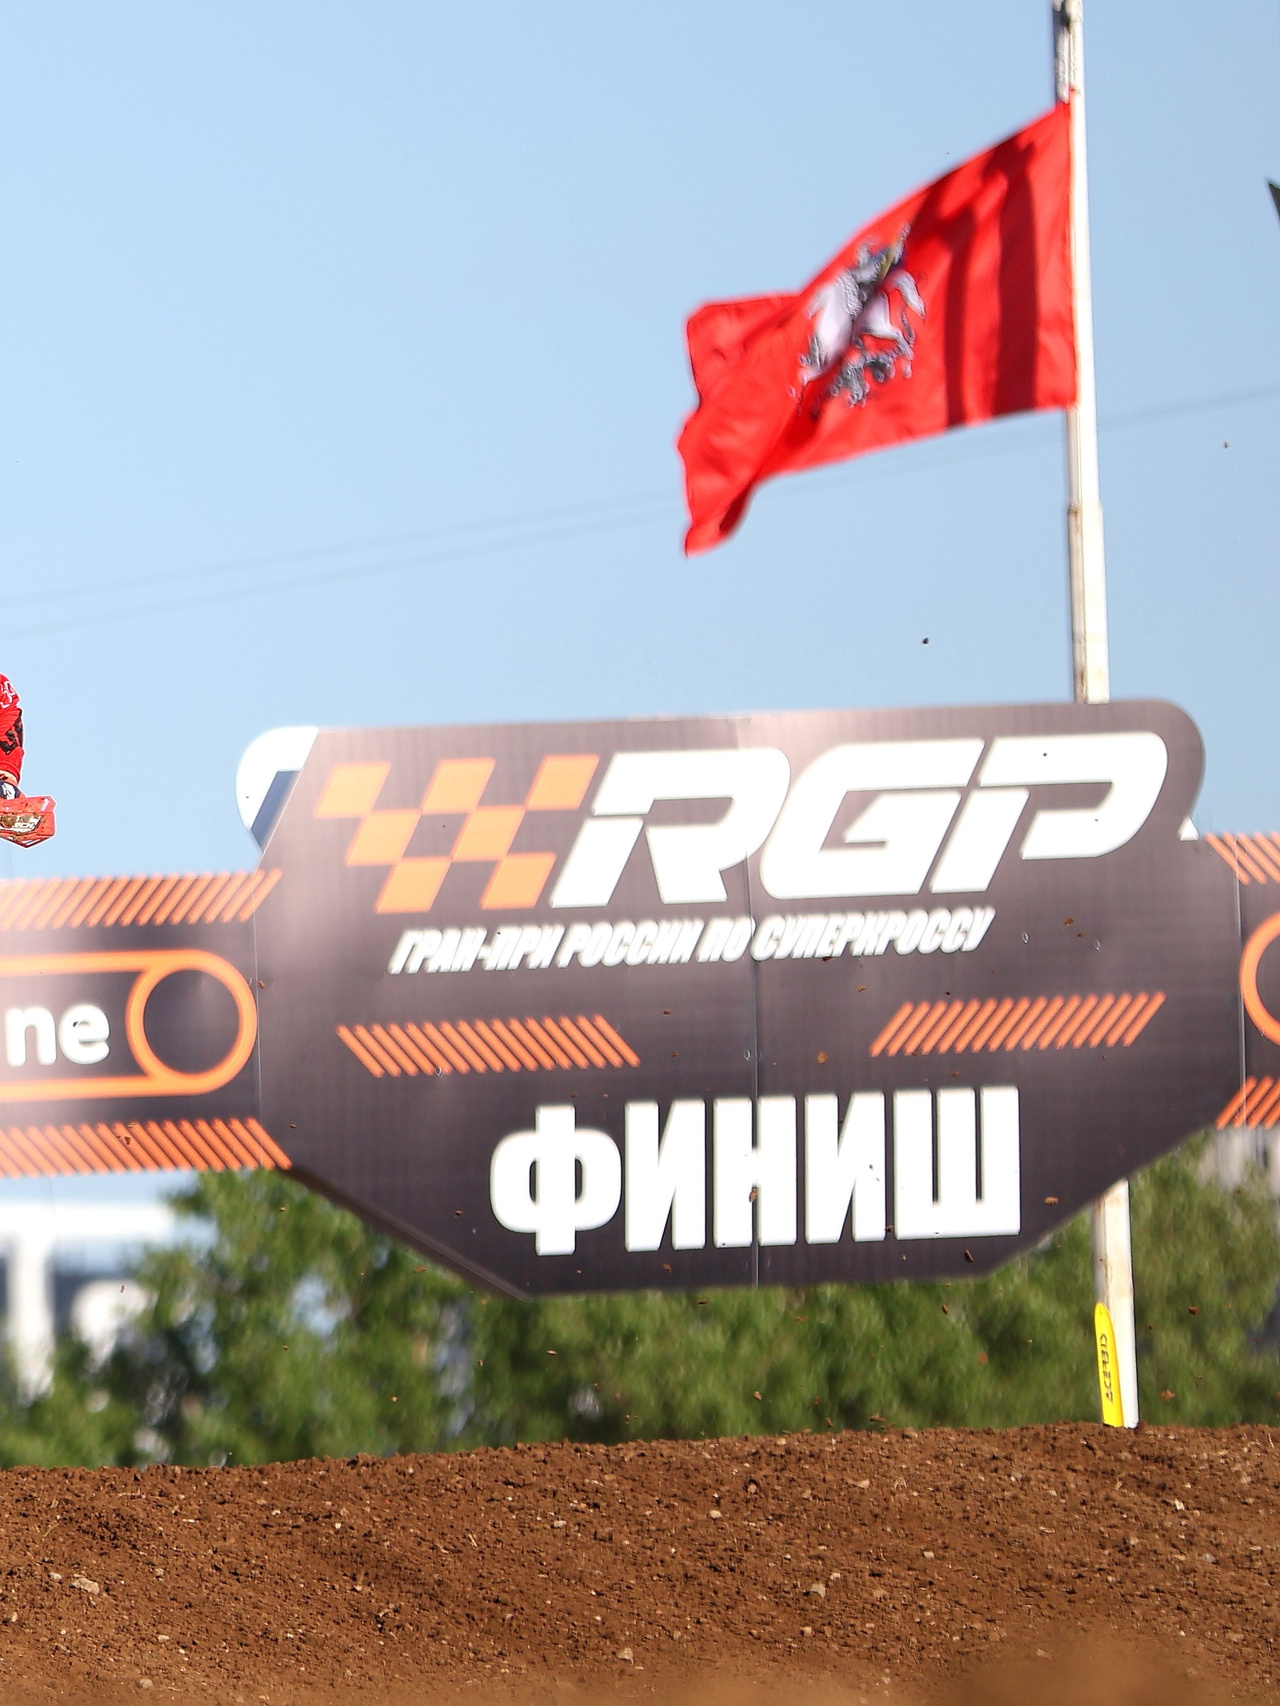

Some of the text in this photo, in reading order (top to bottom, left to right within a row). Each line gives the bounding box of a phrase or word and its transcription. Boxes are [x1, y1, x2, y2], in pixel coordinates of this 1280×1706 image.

[550, 731, 1169, 908] RGP
[388, 905, 997, 975] ГРАН-ПРИ РОССИИ ПО СУПЕРКРОССУ
[490, 1086, 1022, 1257] ФИНИШ
